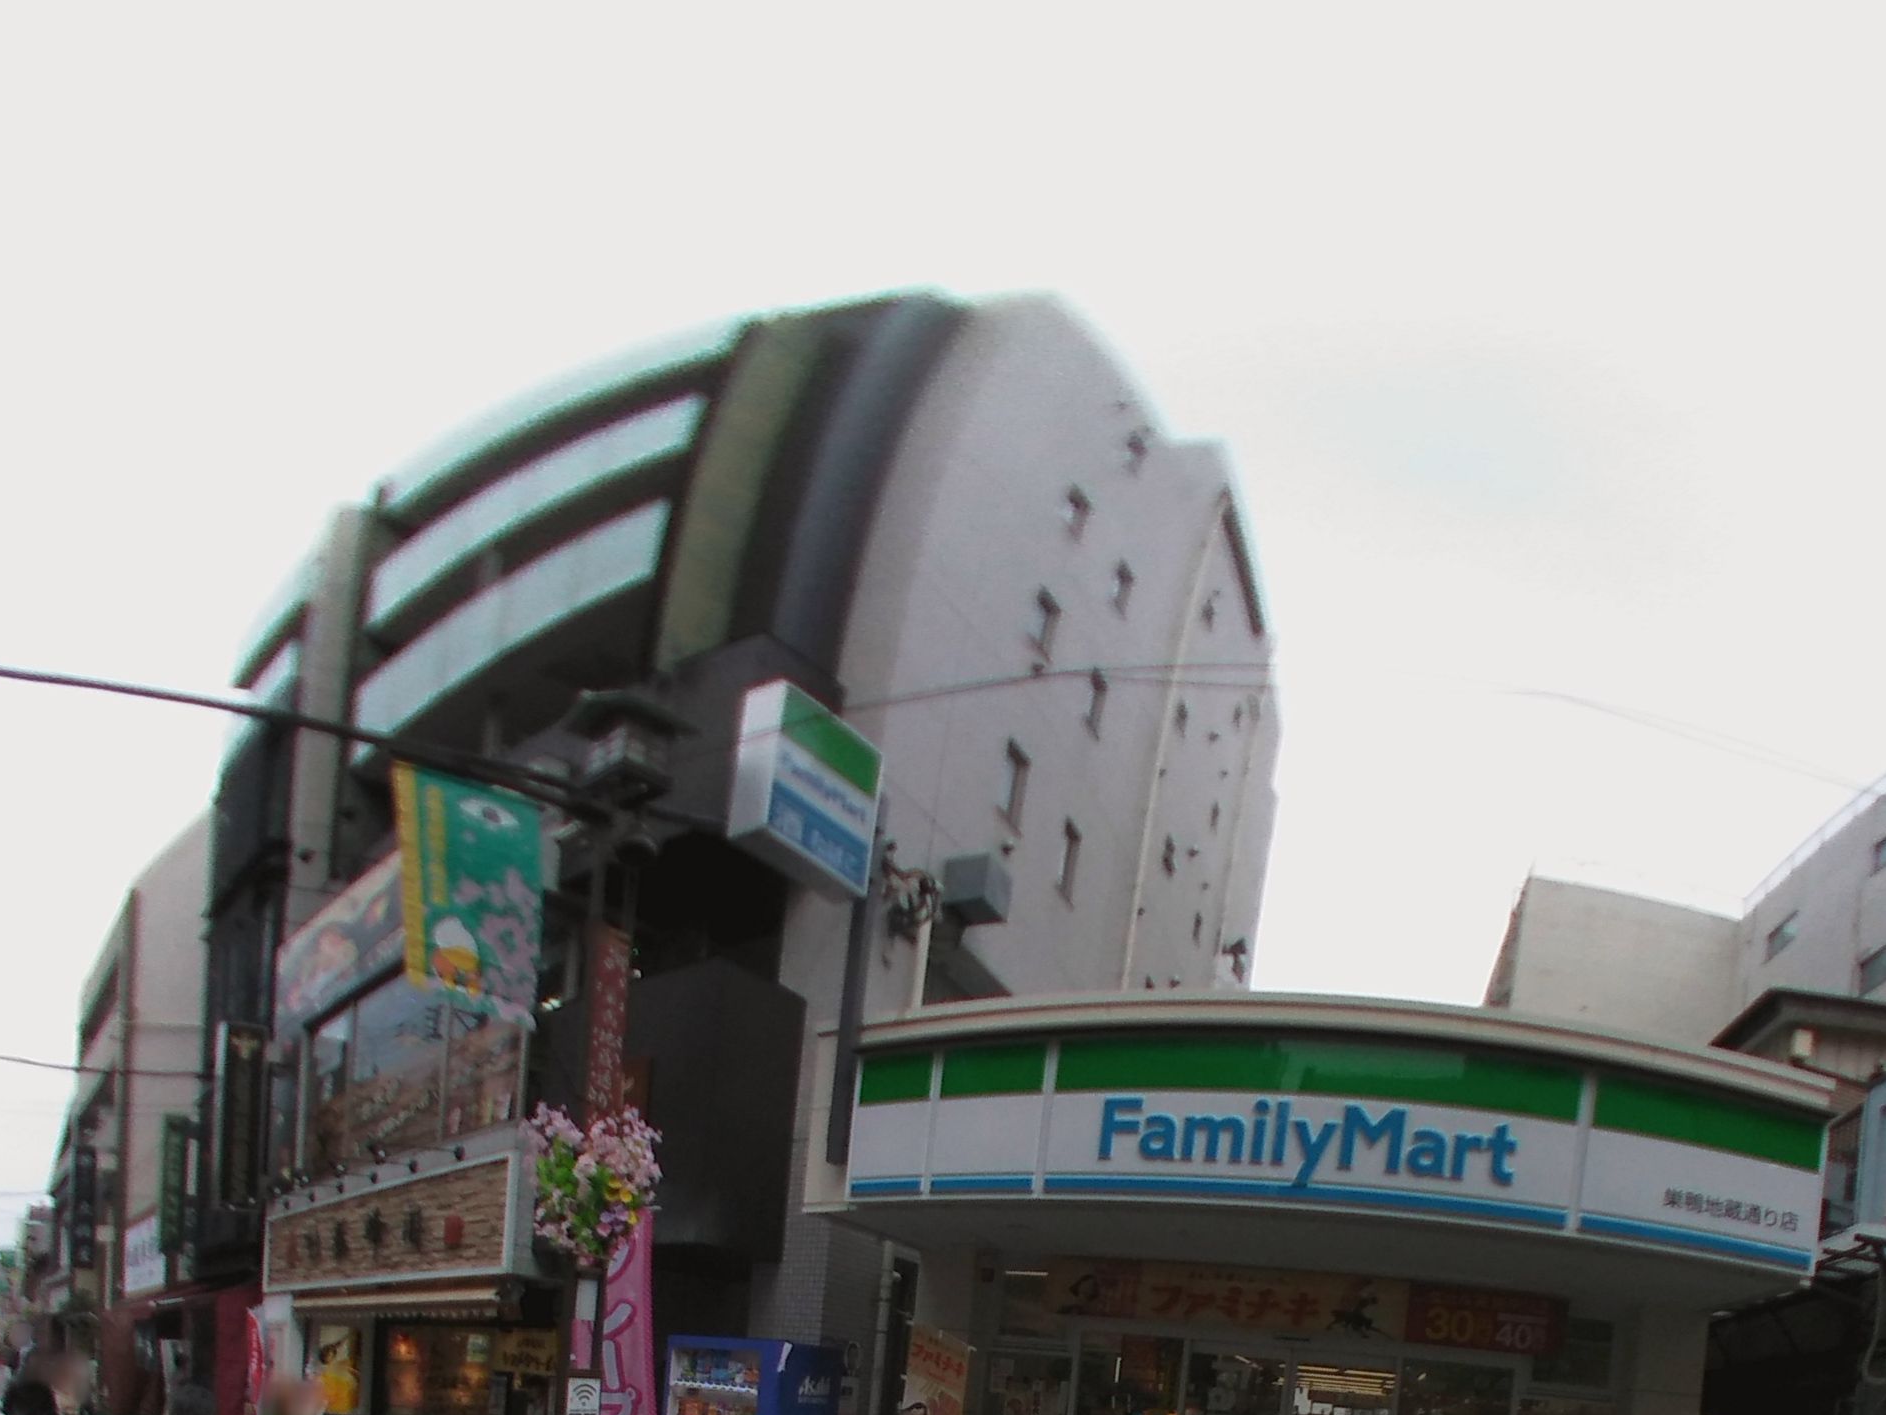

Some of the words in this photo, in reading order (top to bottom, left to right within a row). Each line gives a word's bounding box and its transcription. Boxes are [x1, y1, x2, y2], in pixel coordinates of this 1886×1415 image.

[1097, 1096, 1518, 1190] FamilyMart
[1661, 1186, 1799, 1233] 巣鴨地蔵通り店
[1150, 1284, 1321, 1327] ファミチキ
